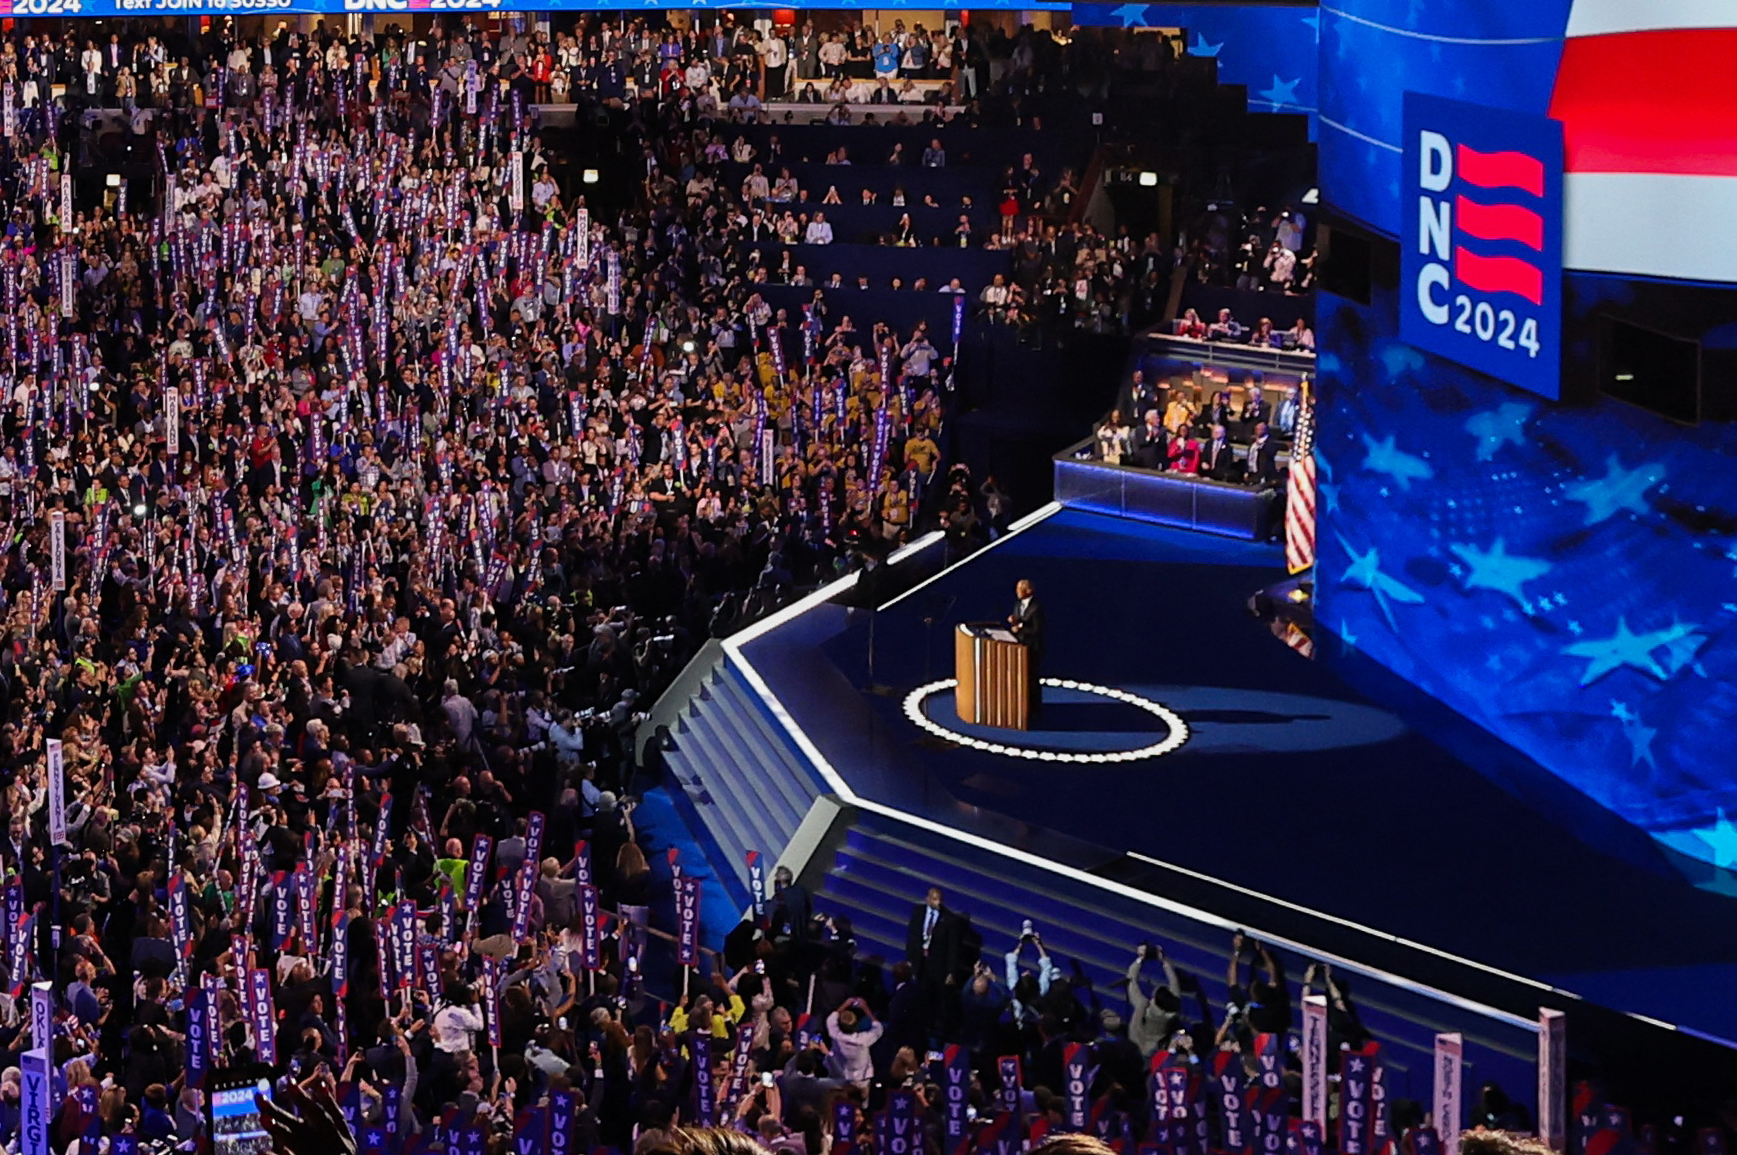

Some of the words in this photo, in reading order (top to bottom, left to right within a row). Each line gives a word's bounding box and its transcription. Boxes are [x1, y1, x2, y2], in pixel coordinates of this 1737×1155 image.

[5, 89, 13, 129] UTAH
[63, 182, 71, 224] ALASKA
[1454, 294, 1541, 359] 2024
[675, 430, 683, 462] VOTE
[374, 808, 389, 853] VOTE
[468, 850, 485, 895] VOTE
[751, 866, 763, 915] VOTE
[174, 892, 187, 942] VOTE
[277, 887, 288, 935] VOTE
[300, 887, 312, 935] VOTE
[516, 878, 532, 925] VOTE
[682, 896, 694, 946] VOTE
[335, 926, 344, 980] VOTE
[402, 917, 413, 967] VOTE
[584, 902, 596, 955] VOTE
[11, 931, 27, 982] VOTE
[35, 1001, 46, 1048] OKLA
[207, 992, 218, 1043] VOTE
[257, 988, 270, 1043] VOTE
[484, 975, 496, 1028] VOTE
[190, 1008, 202, 1069] VOTE
[732, 1042, 750, 1090] VOTE
[222, 1088, 254, 1104] 2024
[948, 1067, 962, 1136] VOTE
[1069, 1063, 1085, 1128] VOTE
[1221, 1075, 1243, 1148] VOTE
[1346, 1079, 1363, 1154] VOTE
